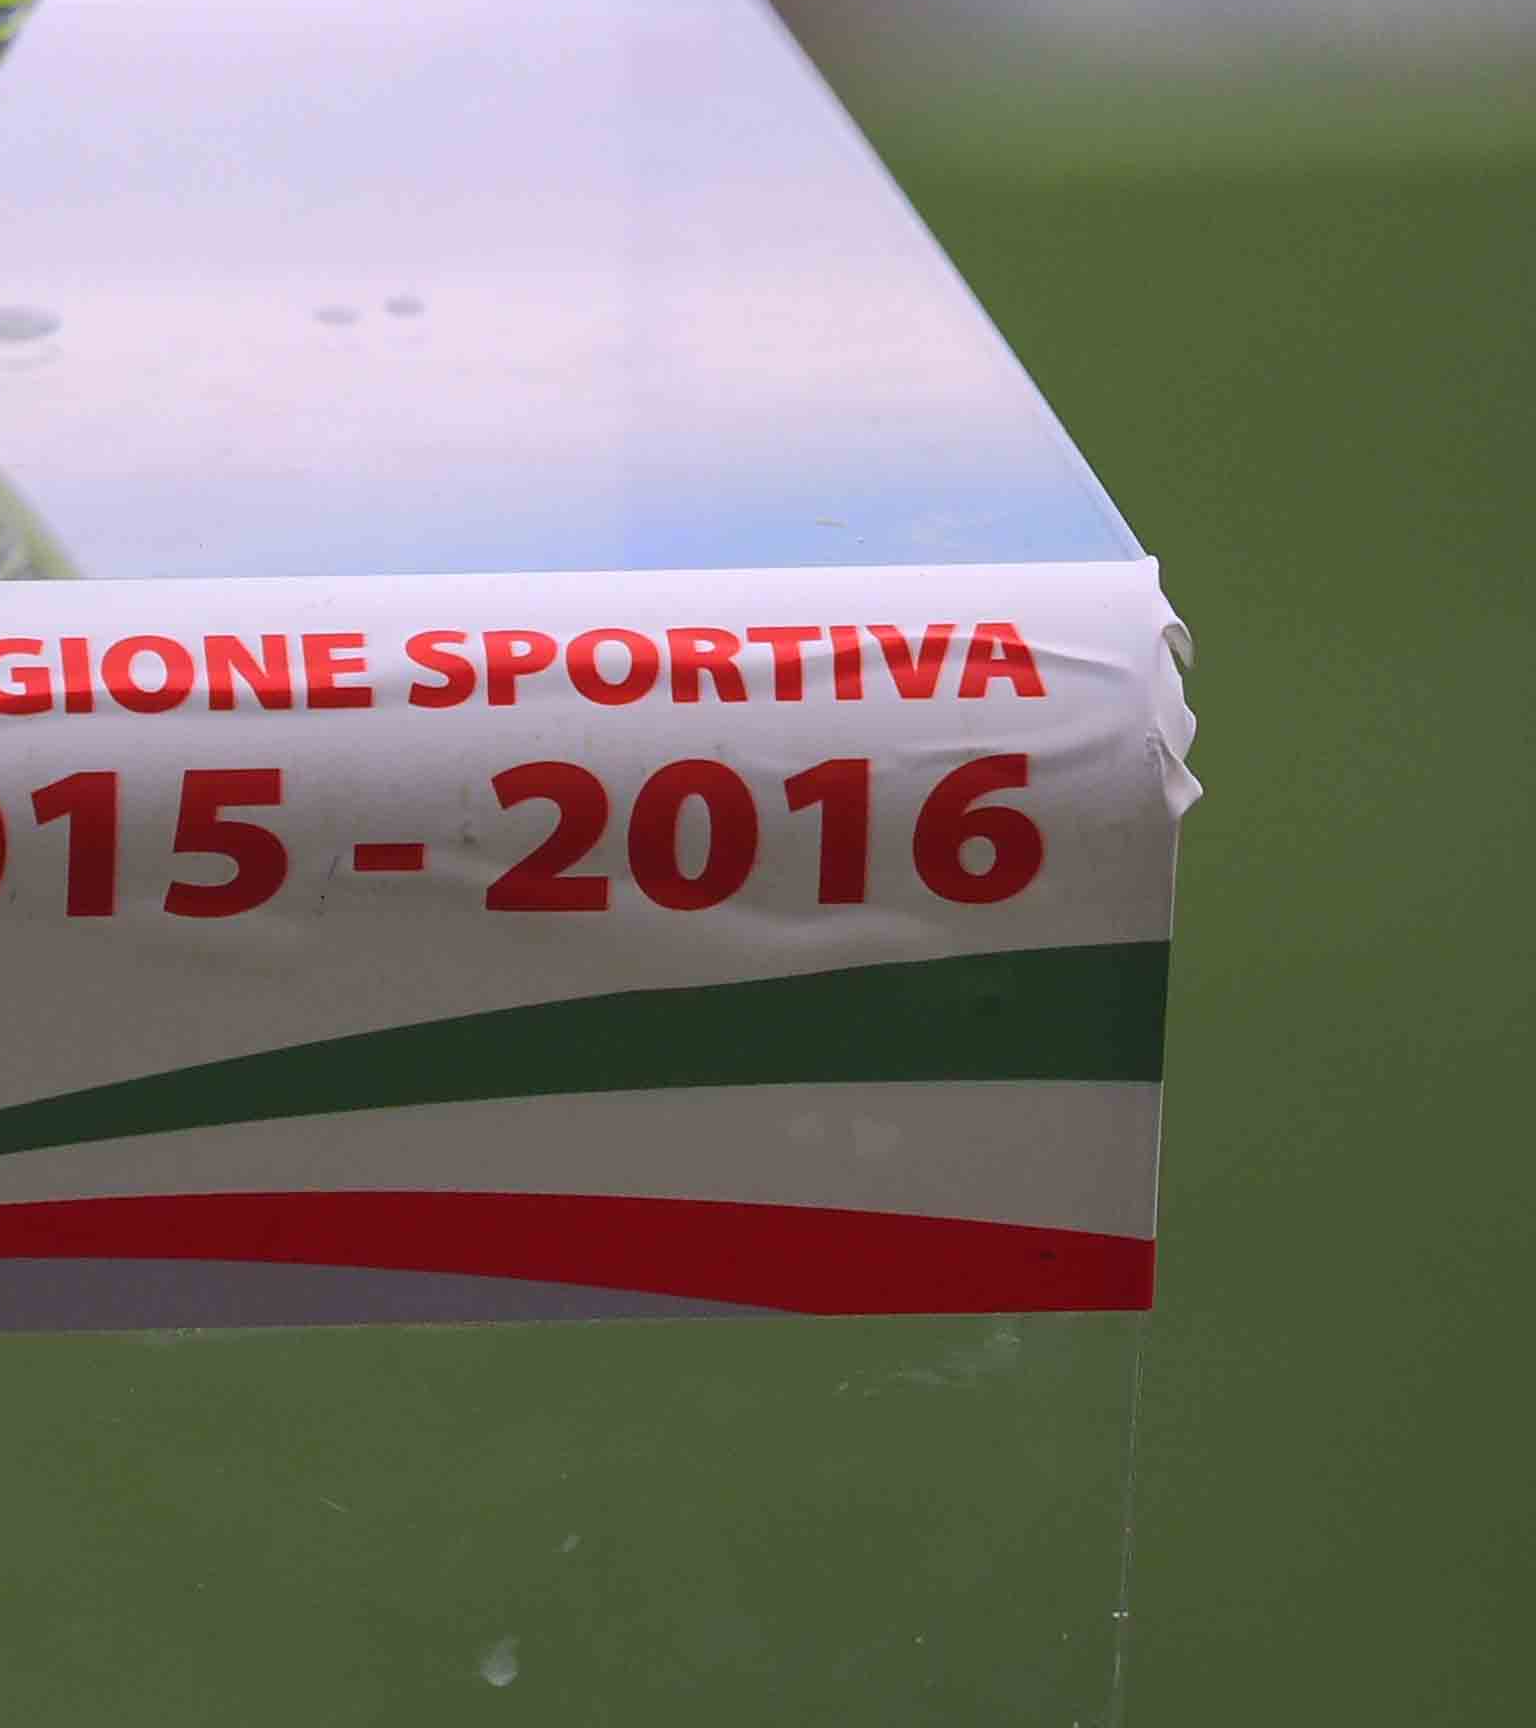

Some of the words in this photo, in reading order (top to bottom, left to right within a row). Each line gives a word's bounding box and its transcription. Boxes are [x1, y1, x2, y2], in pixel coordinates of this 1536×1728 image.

[404, 621, 1047, 708] SPORTIVA
[353, 842, 424, 872] -
[485, 753, 1045, 912] 2016
